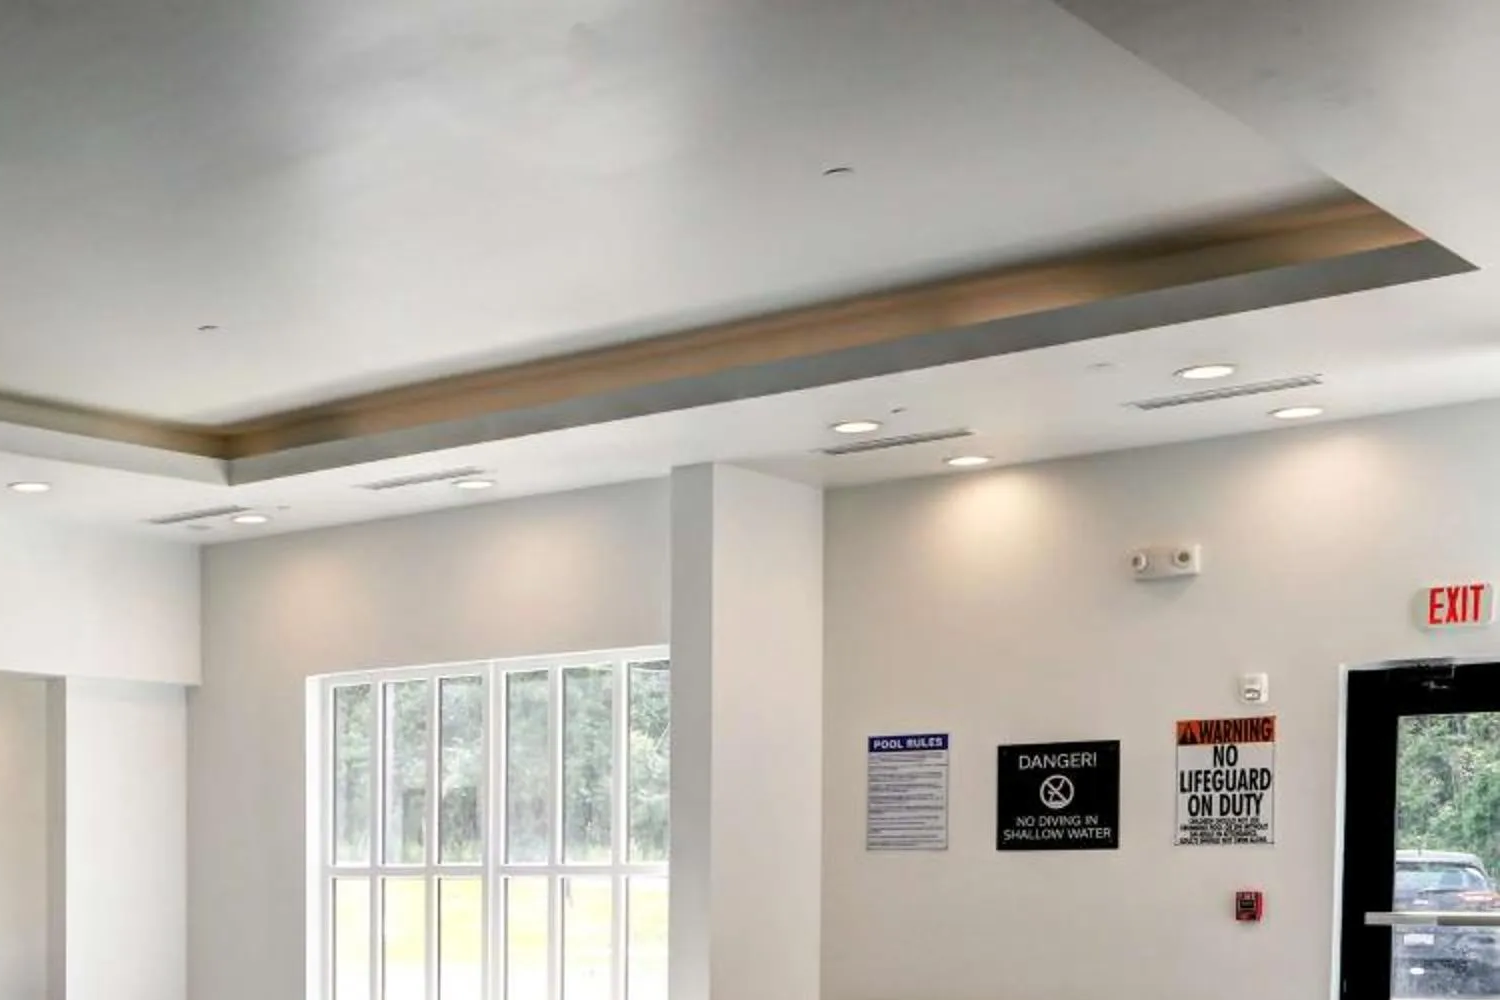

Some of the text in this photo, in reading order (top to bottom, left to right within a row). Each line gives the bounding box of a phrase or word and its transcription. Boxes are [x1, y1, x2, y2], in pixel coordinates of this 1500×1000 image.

[1428, 584, 1484, 625] EXIT
[1200, 717, 1272, 744] WARNING
[873, 737, 943, 749] POOL RULES
[1018, 751, 1097, 770] DANGER!
[1213, 745, 1238, 768] NO
[1180, 768, 1271, 793] LIFEGUARD
[1188, 793, 1264, 817] ON DUTY
[1016, 815, 1099, 827] NO DIVING IN
[1003, 828, 1111, 841] SHALLOW WATER
